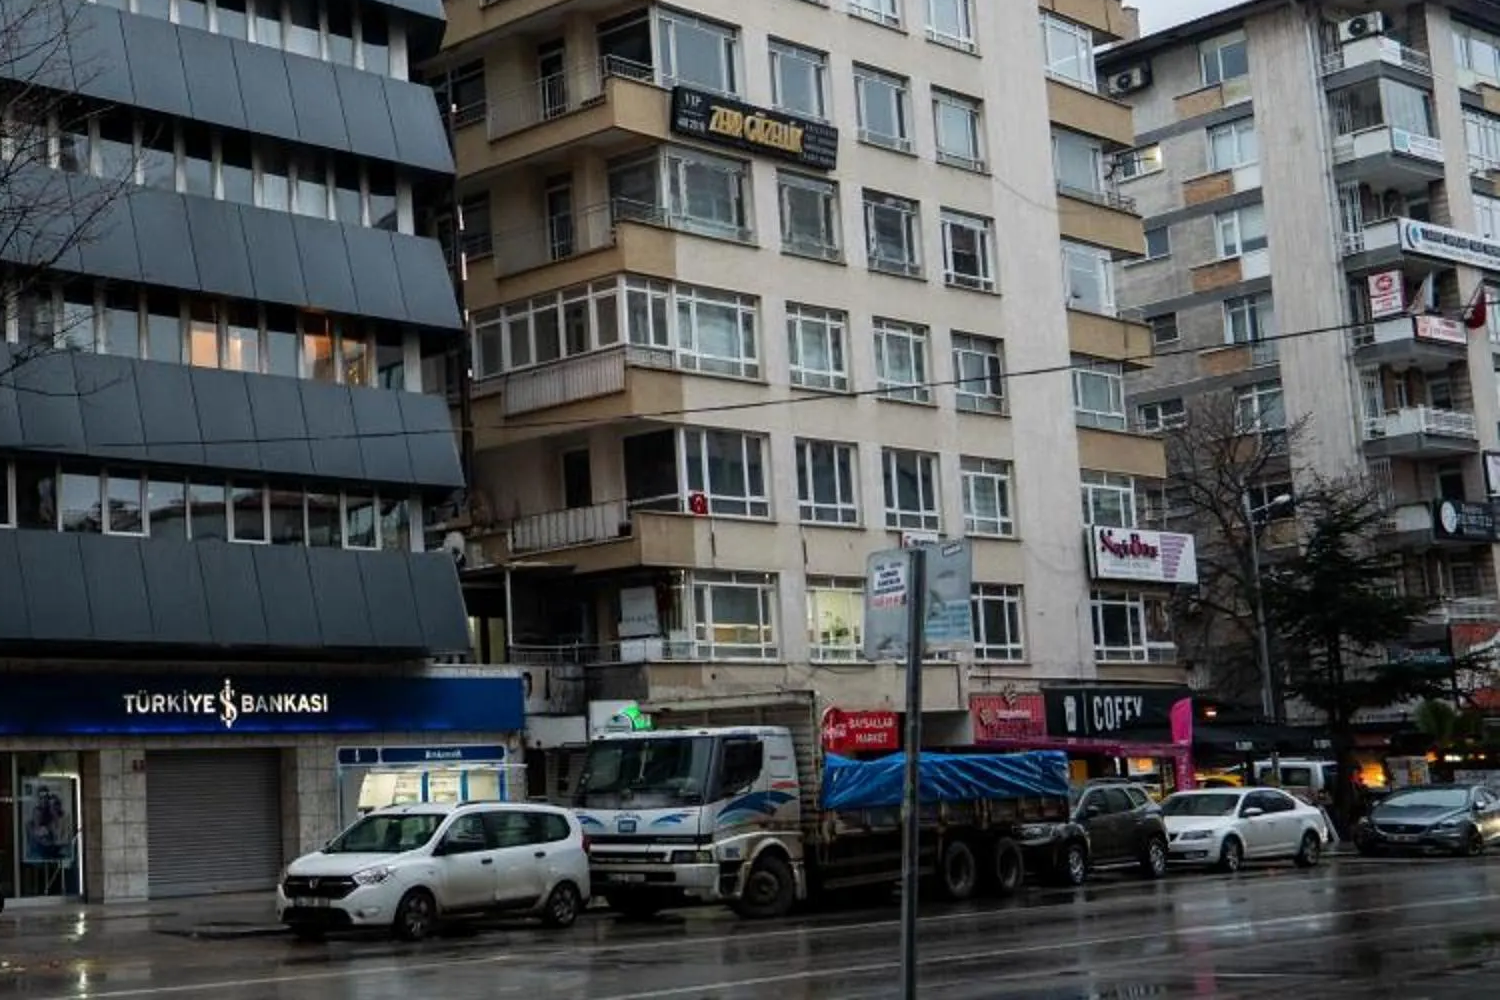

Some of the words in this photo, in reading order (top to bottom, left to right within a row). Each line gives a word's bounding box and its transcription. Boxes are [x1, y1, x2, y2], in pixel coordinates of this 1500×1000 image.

[124, 688, 217, 714] TÜRKİYE
[241, 694, 329, 714] BANKASI
[1092, 696, 1143, 731] COFFY
